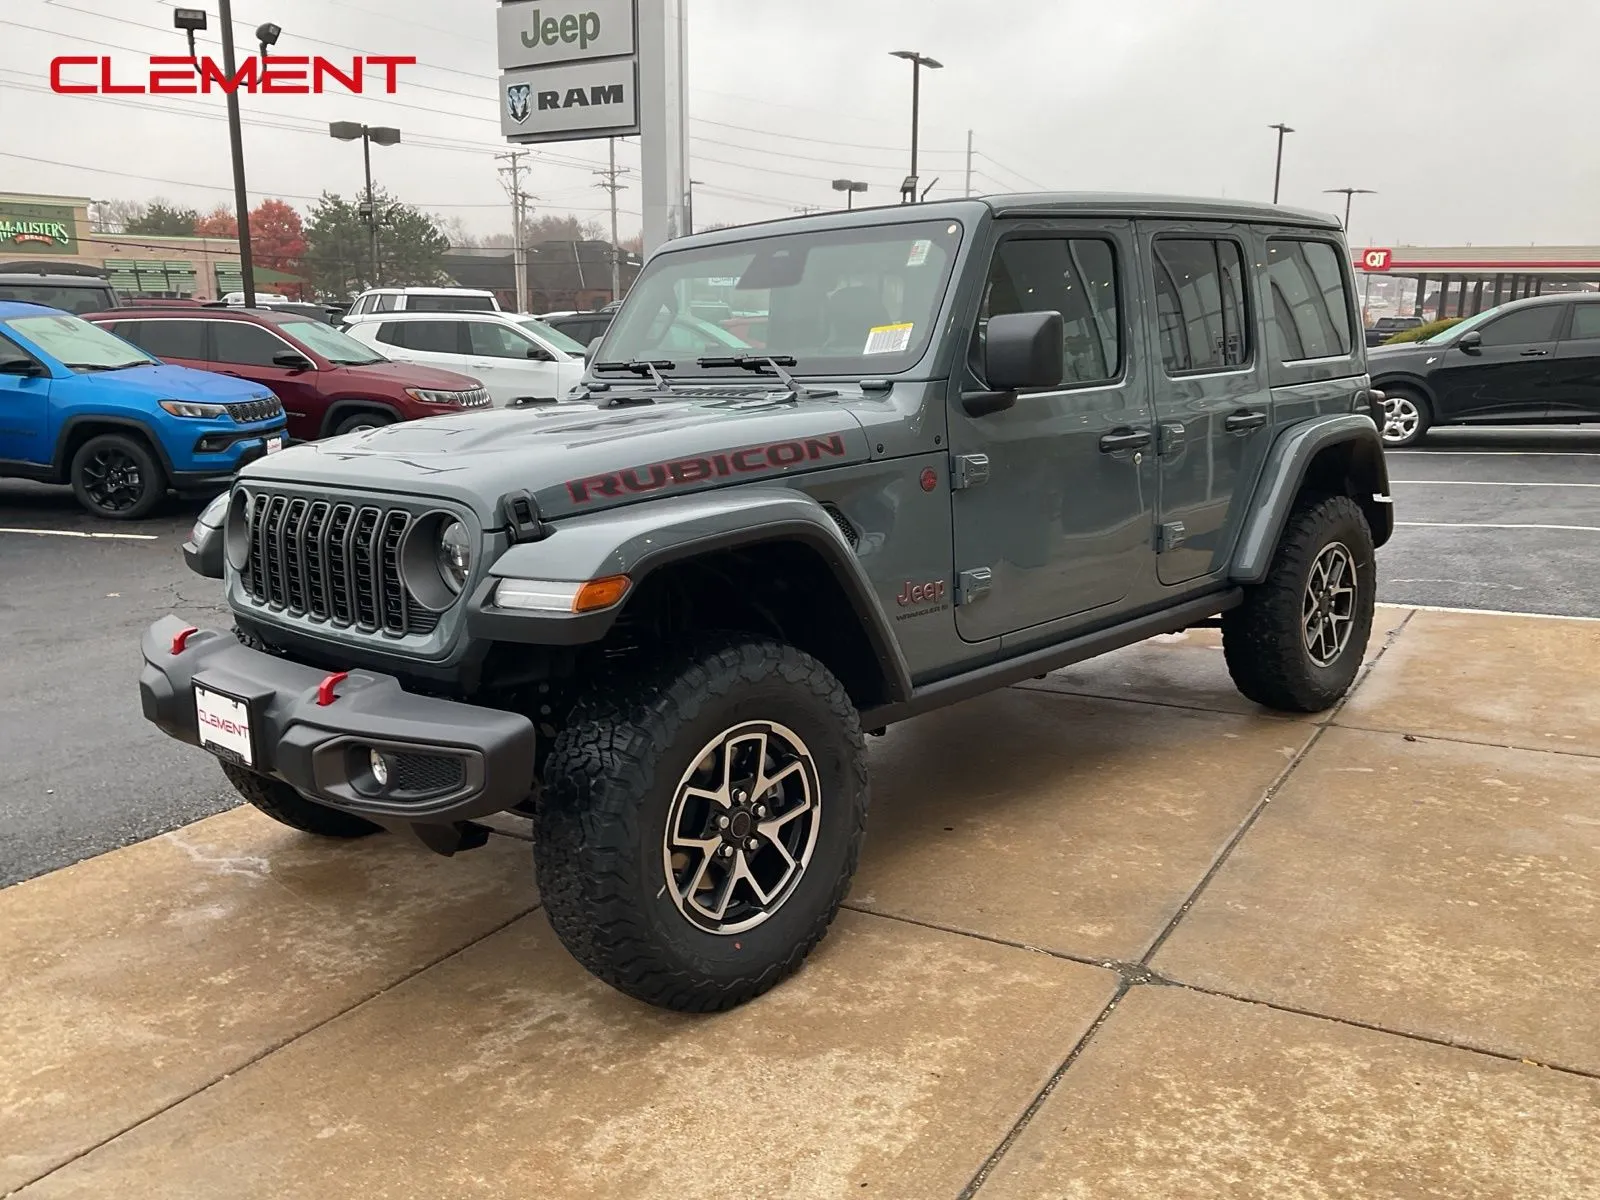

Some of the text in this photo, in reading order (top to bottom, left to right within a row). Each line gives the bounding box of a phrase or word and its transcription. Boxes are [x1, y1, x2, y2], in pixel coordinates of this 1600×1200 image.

[520, 9, 600, 50] Jeep
[538, 84, 623, 110] RAM
[1366, 251, 1387, 267] QT
[566, 433, 845, 504] RUBICON
[897, 580, 944, 607] Jeep
[199, 709, 249, 739] CLEMENT
